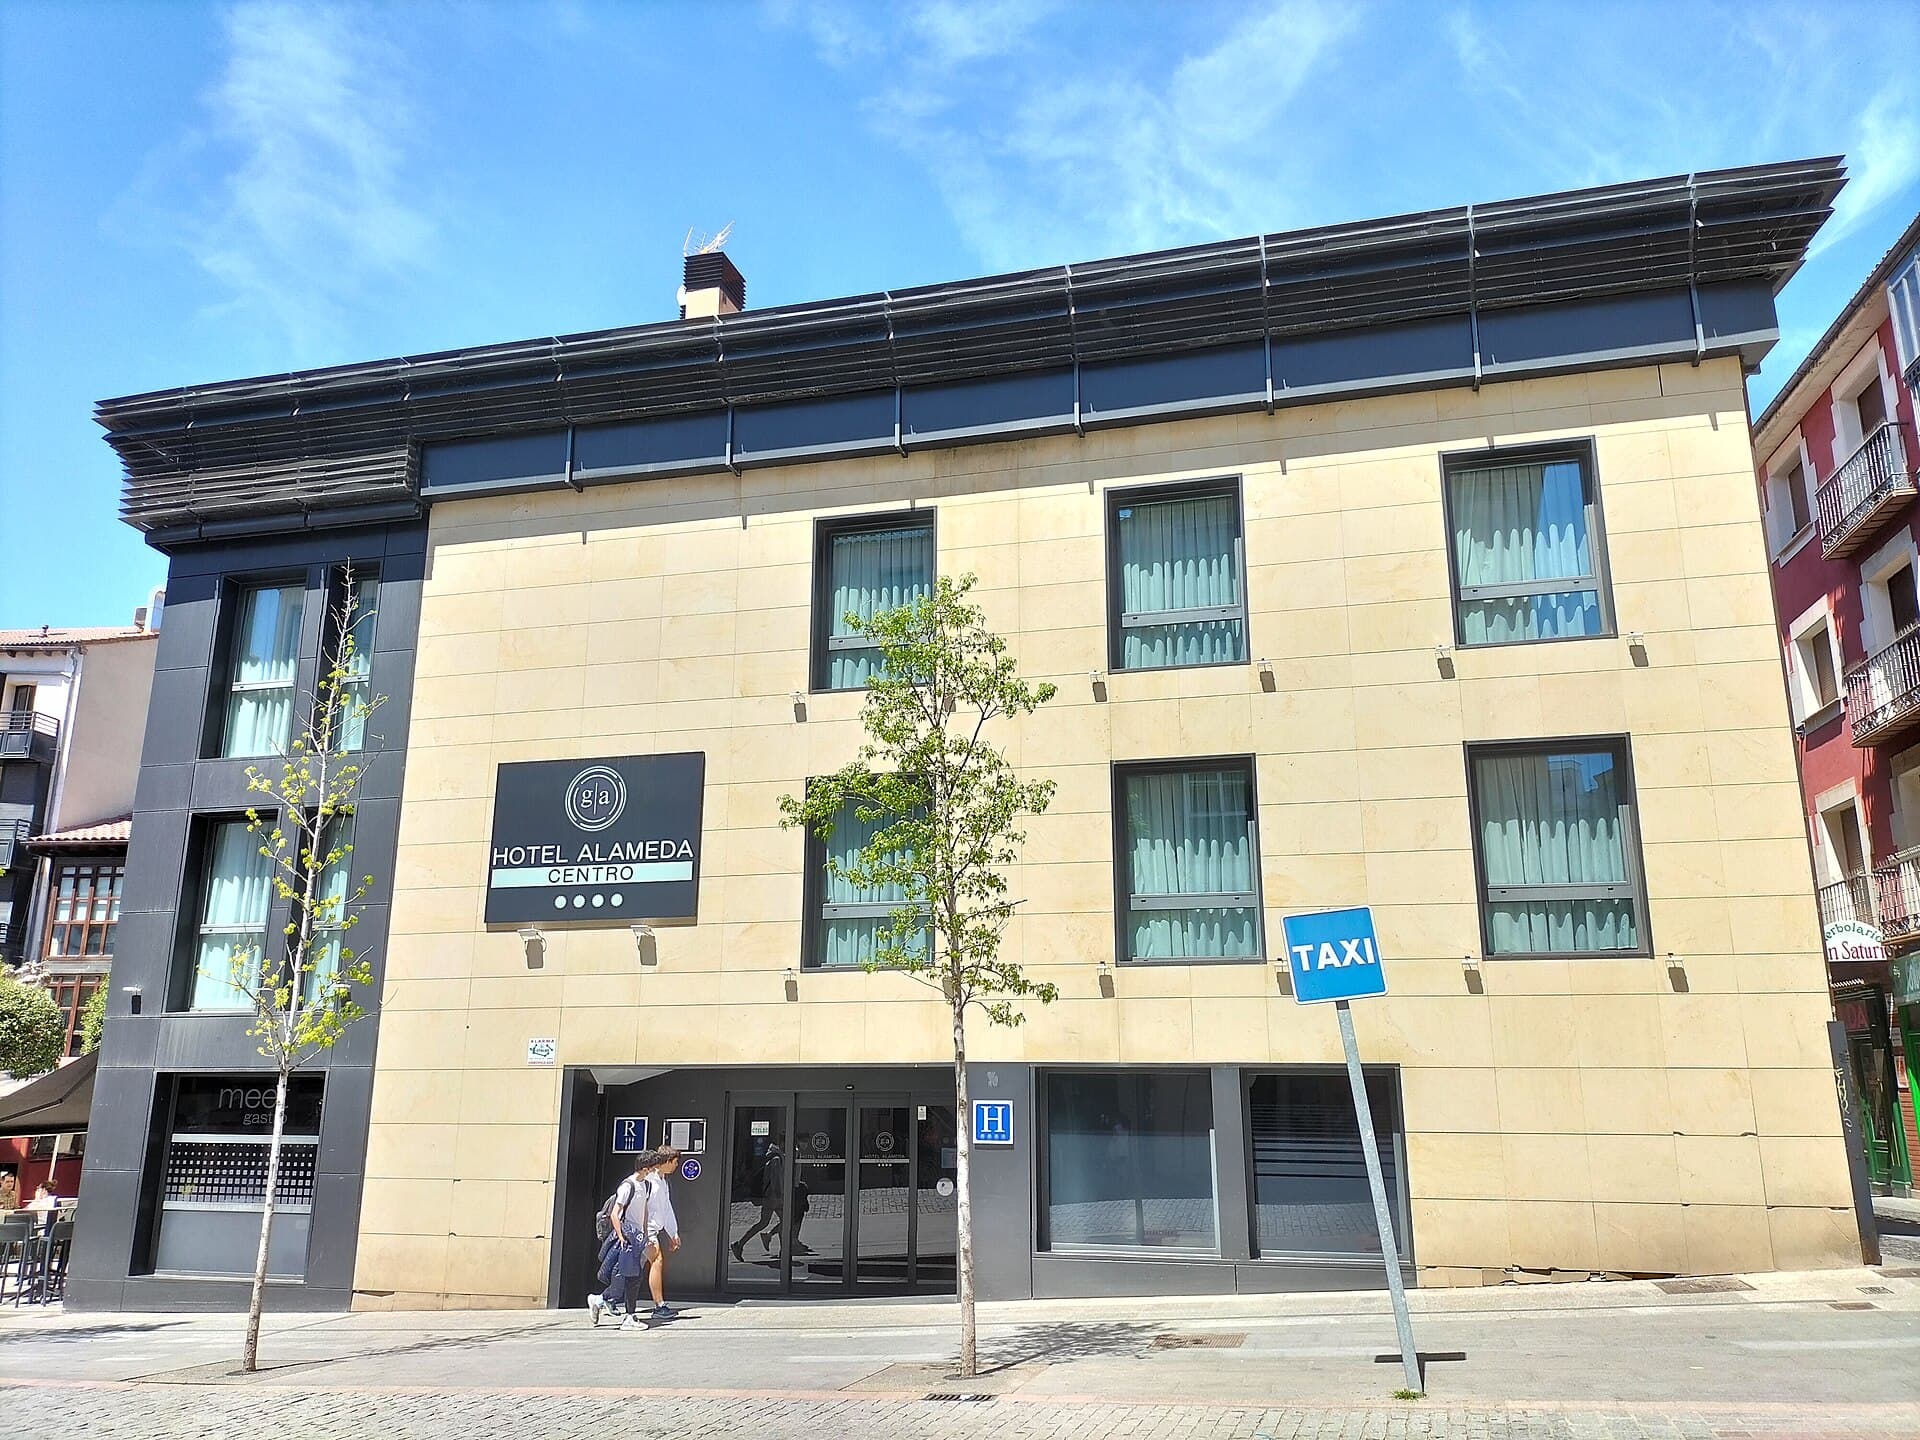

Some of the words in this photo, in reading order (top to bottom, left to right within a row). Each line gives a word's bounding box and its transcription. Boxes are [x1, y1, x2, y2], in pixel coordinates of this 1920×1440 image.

[492, 845, 568, 866] HOTEL
[577, 839, 694, 863] ALAMEDA
[548, 866, 634, 884] CENTRO
[1825, 922, 1882, 943] erbolario
[1291, 937, 1376, 972] TAXI
[623, 1120, 637, 1137] R
[980, 1105, 1006, 1133] H
